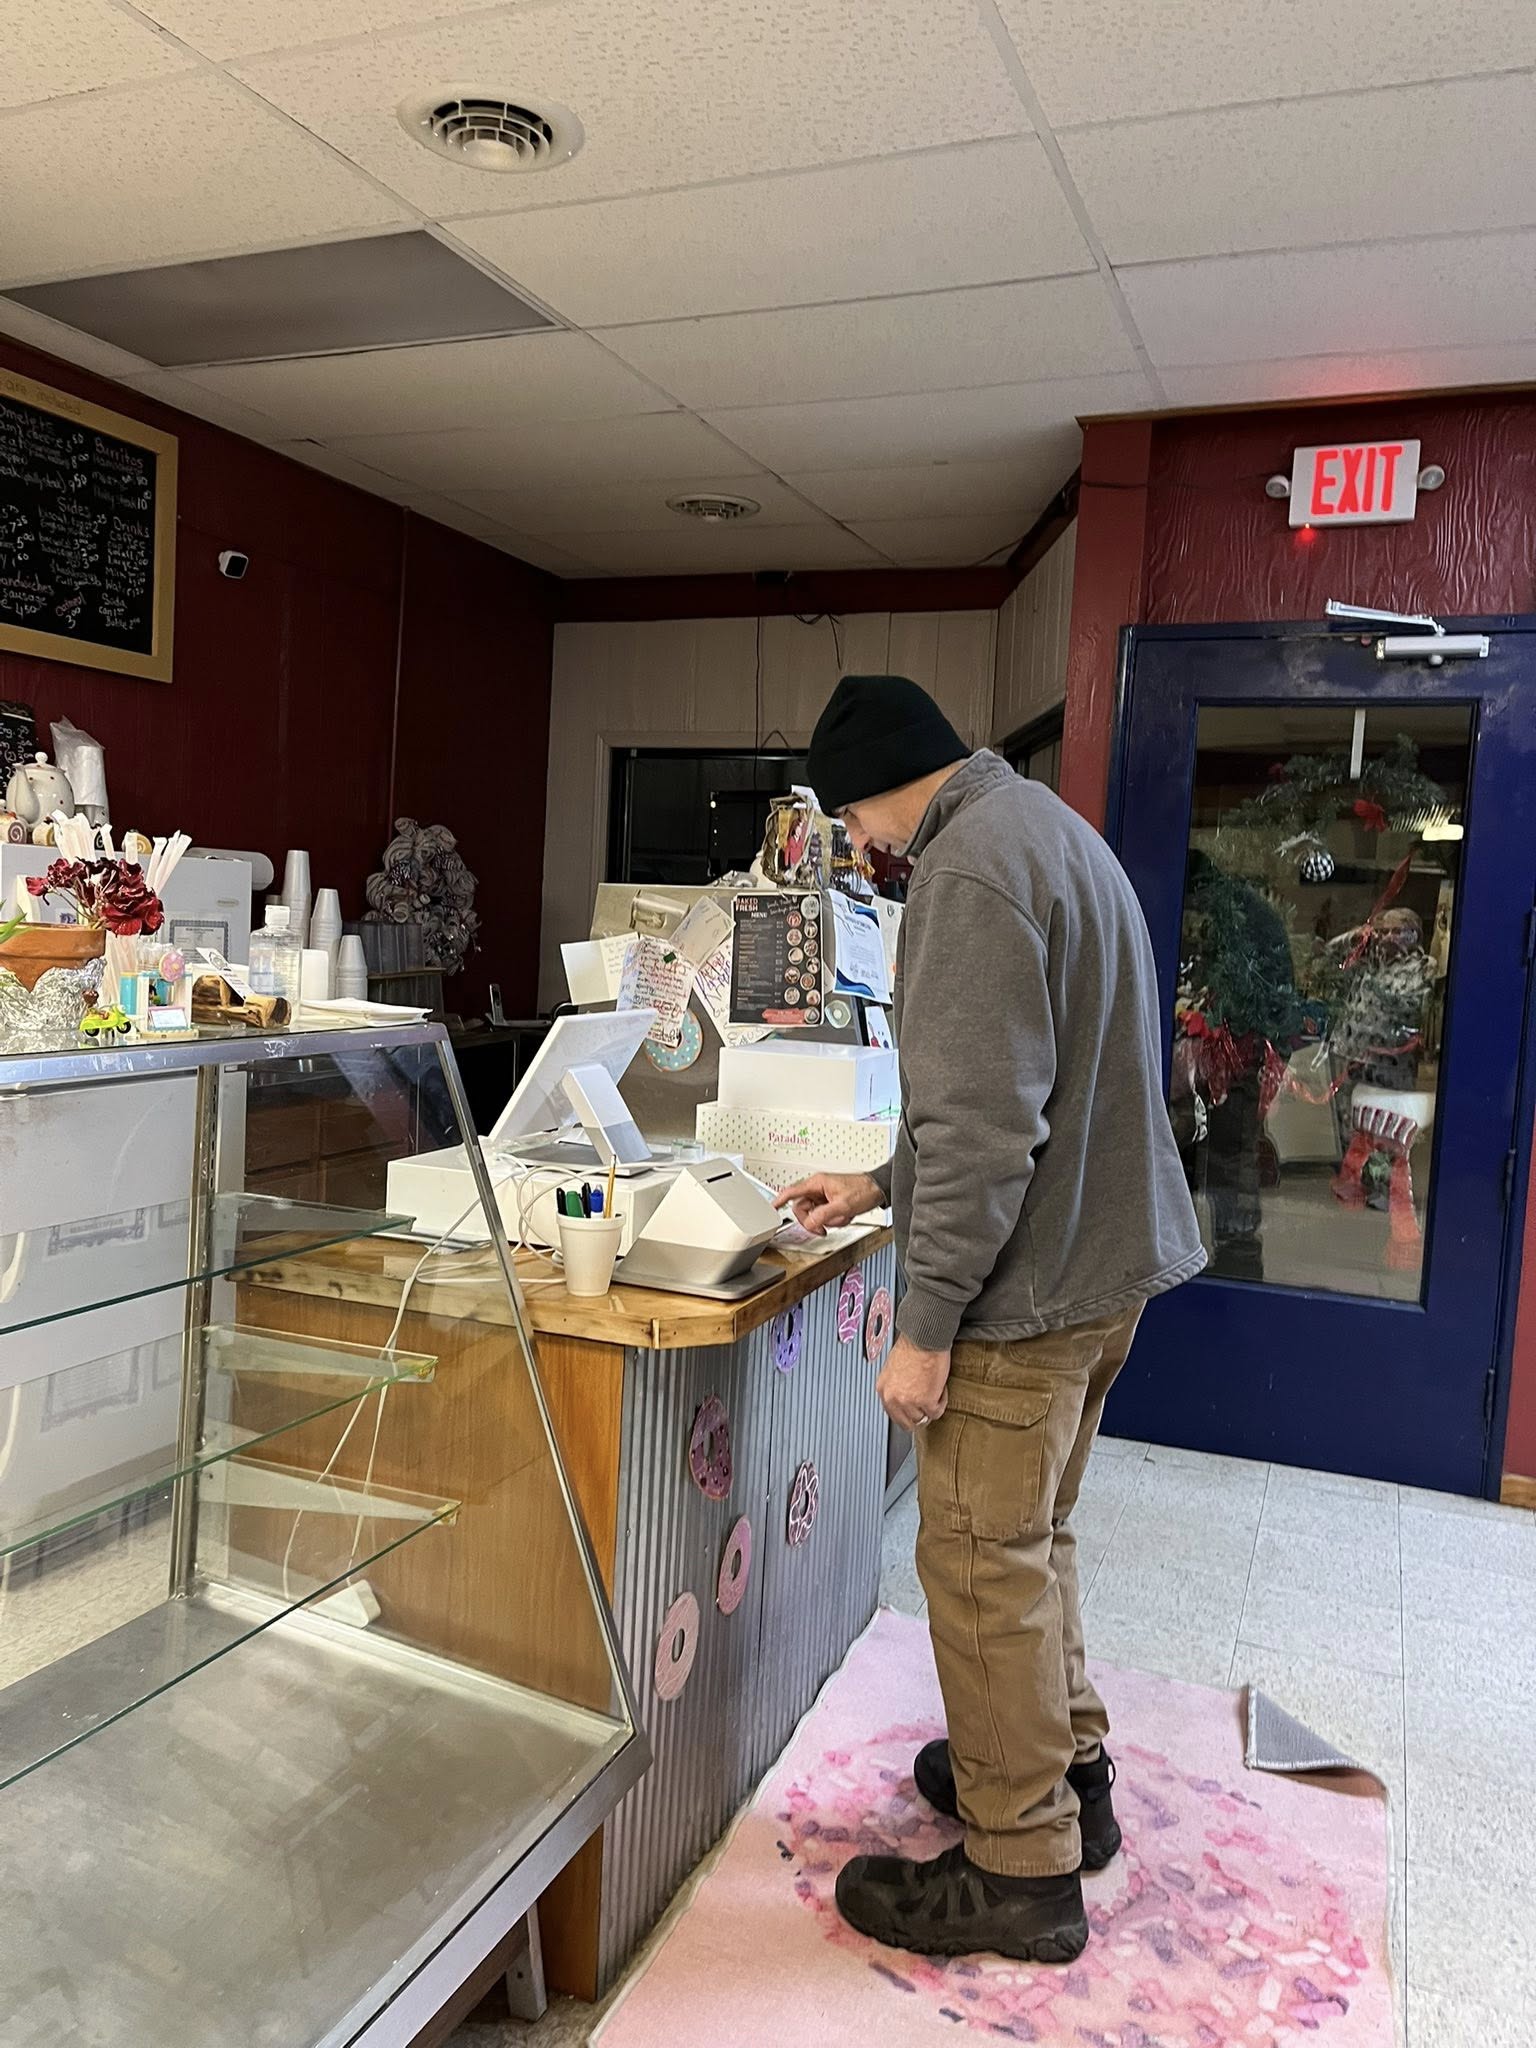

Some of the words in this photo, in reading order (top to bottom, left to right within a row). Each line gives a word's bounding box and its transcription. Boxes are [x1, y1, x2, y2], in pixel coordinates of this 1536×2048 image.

[1311, 444, 1404, 516] EXIT
[113, 516, 150, 539] Drinks
[735, 897, 759, 905] BAKED
[735, 904, 759, 912] FRESH
[750, 911, 768, 919] MENU
[768, 1131, 810, 1146] Paradise
